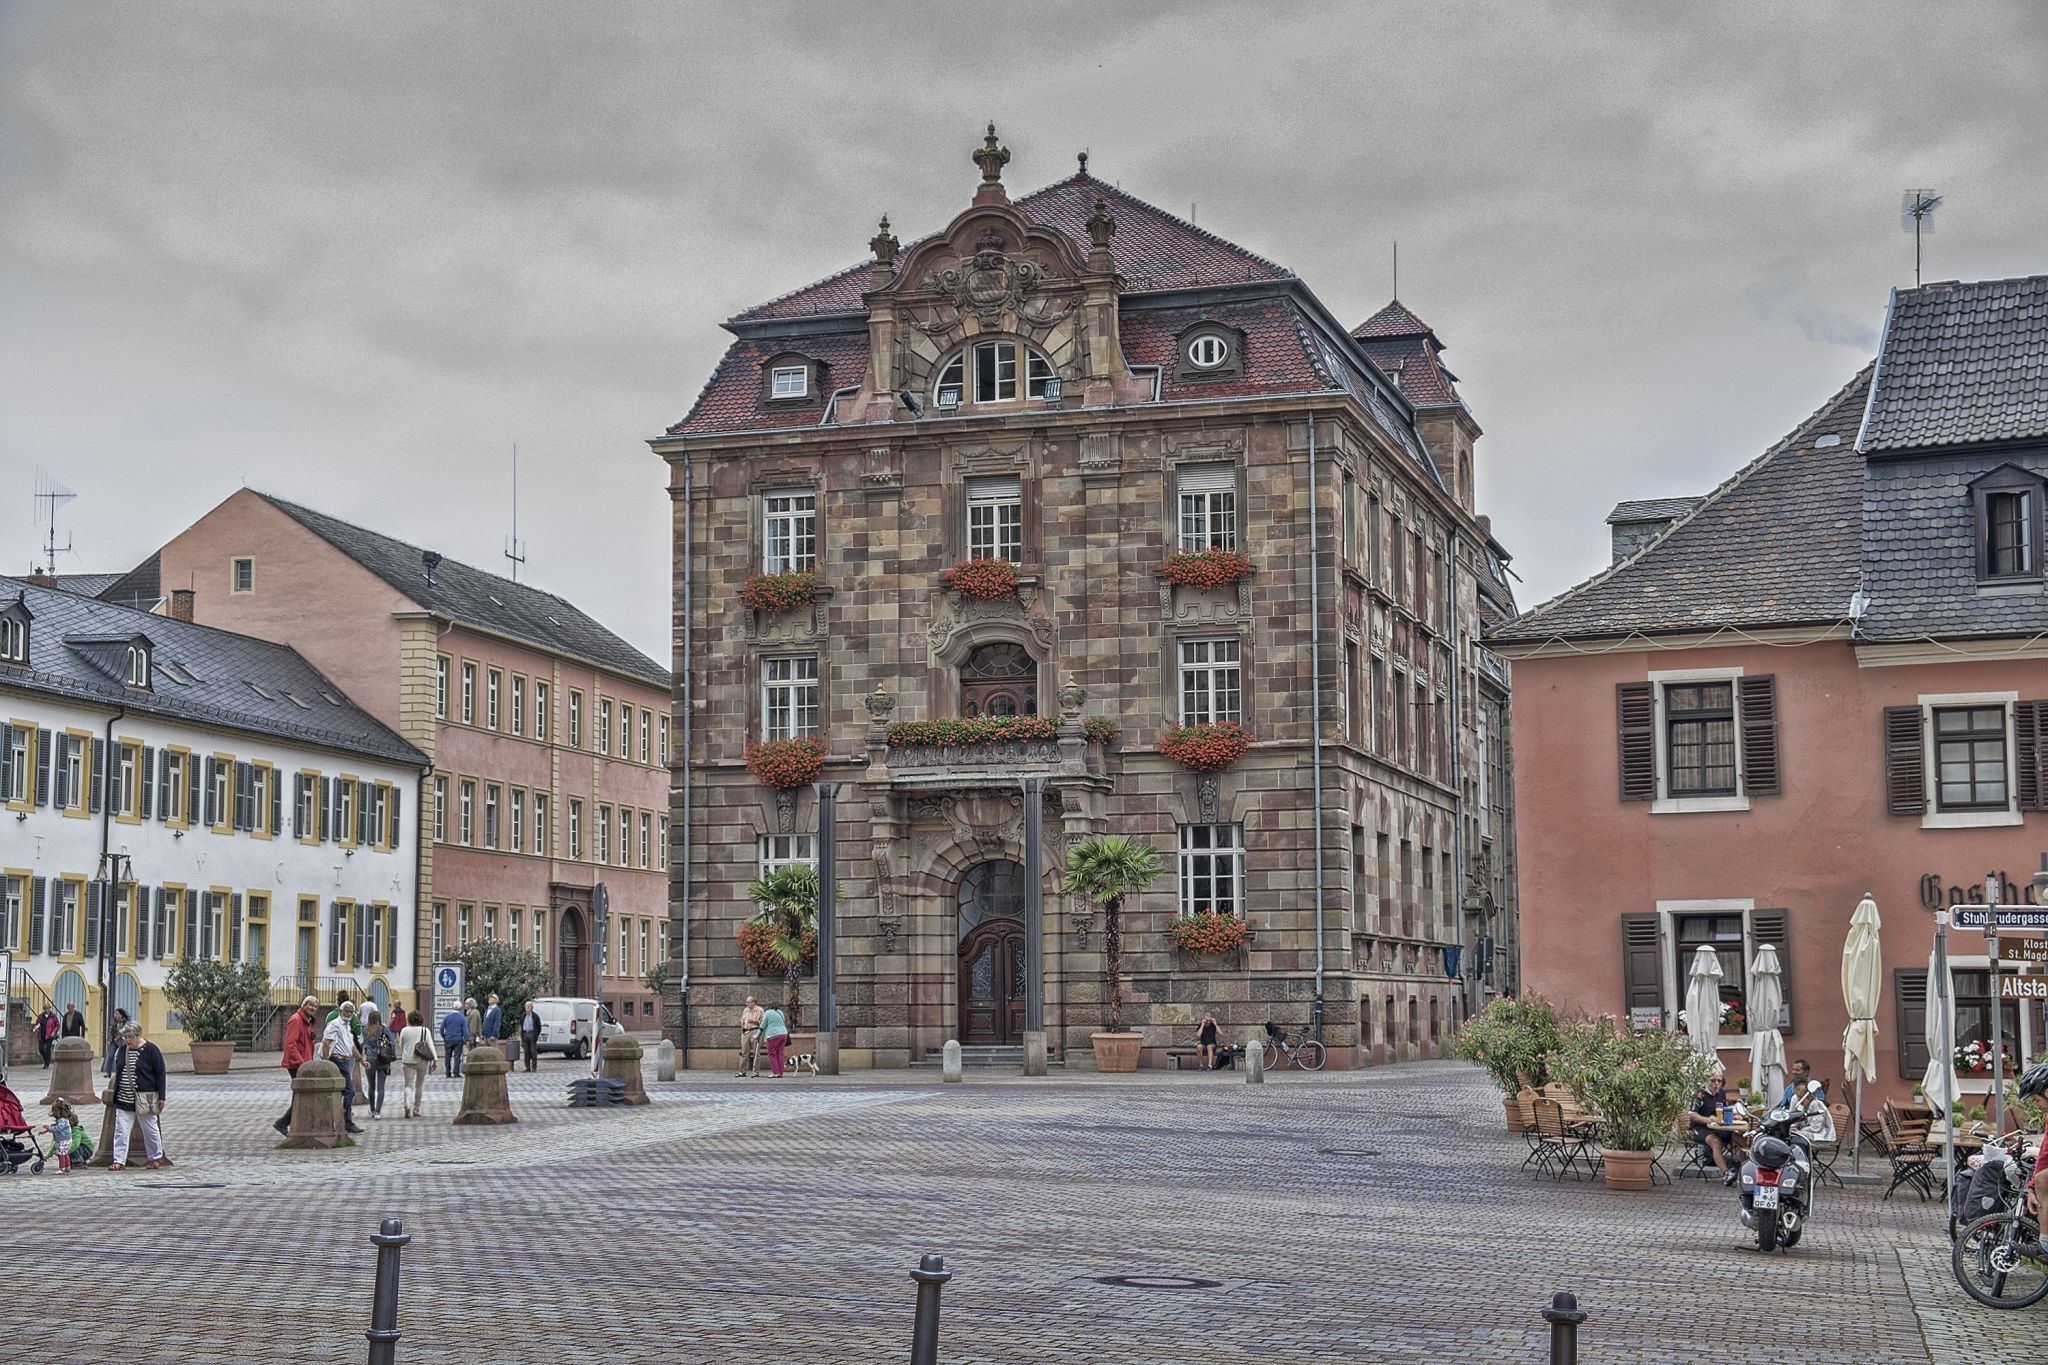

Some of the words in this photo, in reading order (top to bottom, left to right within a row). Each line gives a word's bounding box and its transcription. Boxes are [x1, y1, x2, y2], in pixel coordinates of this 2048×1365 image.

[1921, 870, 2036, 909] Gash
[1963, 912, 2048, 926] Stuhludergasse
[2009, 949, 2021, 959] St.
[2023, 950, 2048, 960] Magd
[2002, 977, 2047, 996] Altsta
